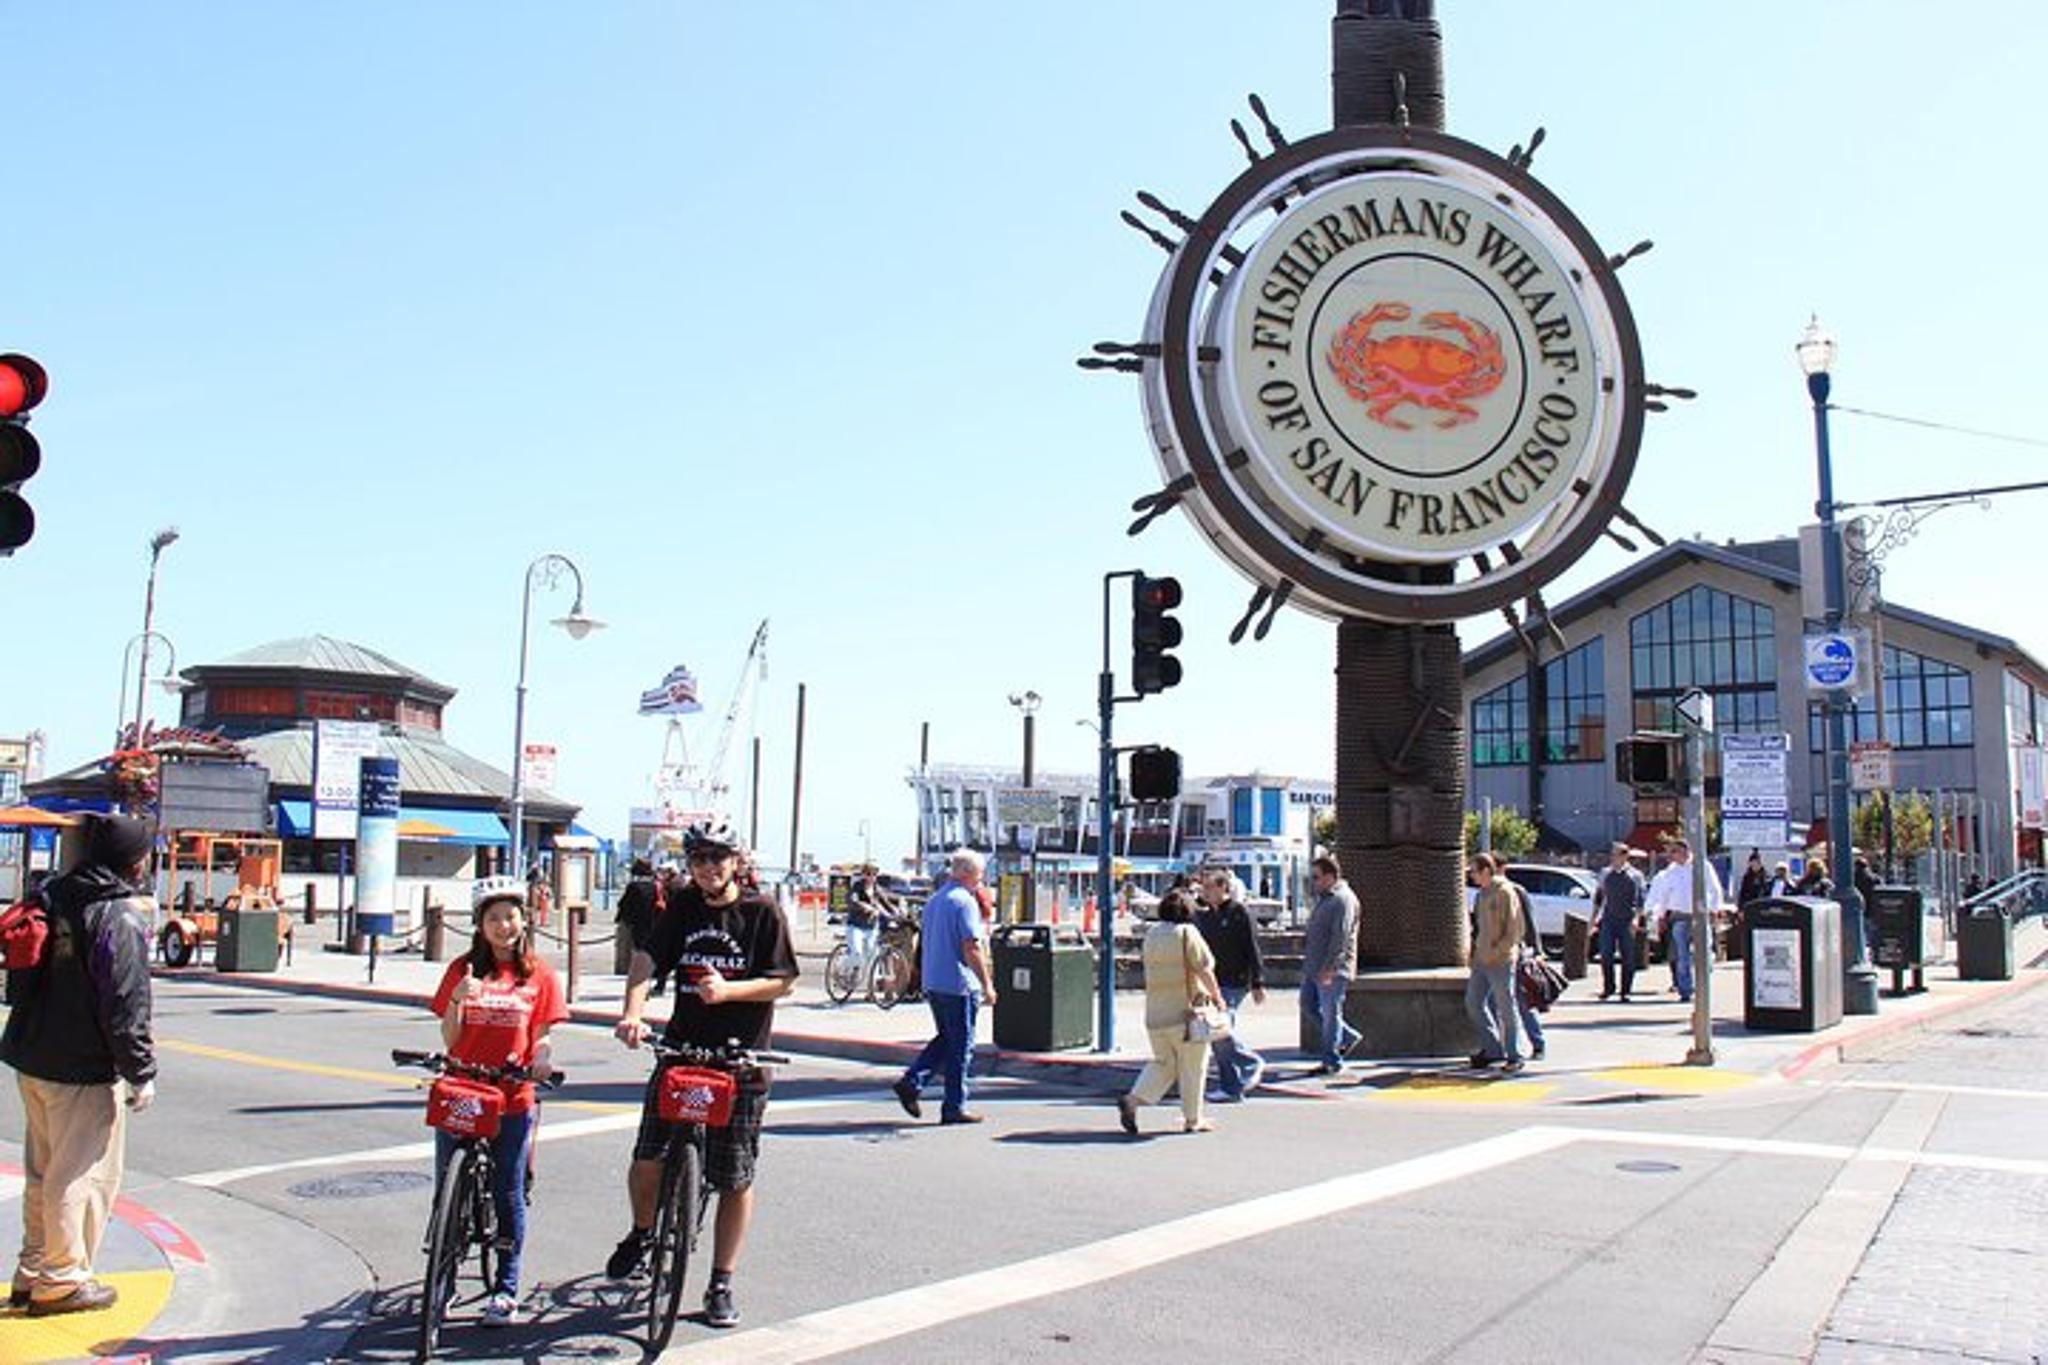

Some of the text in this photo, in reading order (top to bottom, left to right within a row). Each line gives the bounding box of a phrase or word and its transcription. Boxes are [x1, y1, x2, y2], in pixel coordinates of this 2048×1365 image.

[1252, 196, 1580, 374] FISHERMANS WHARF
[1257, 379, 1579, 536] OF SAN FRANCISCO
